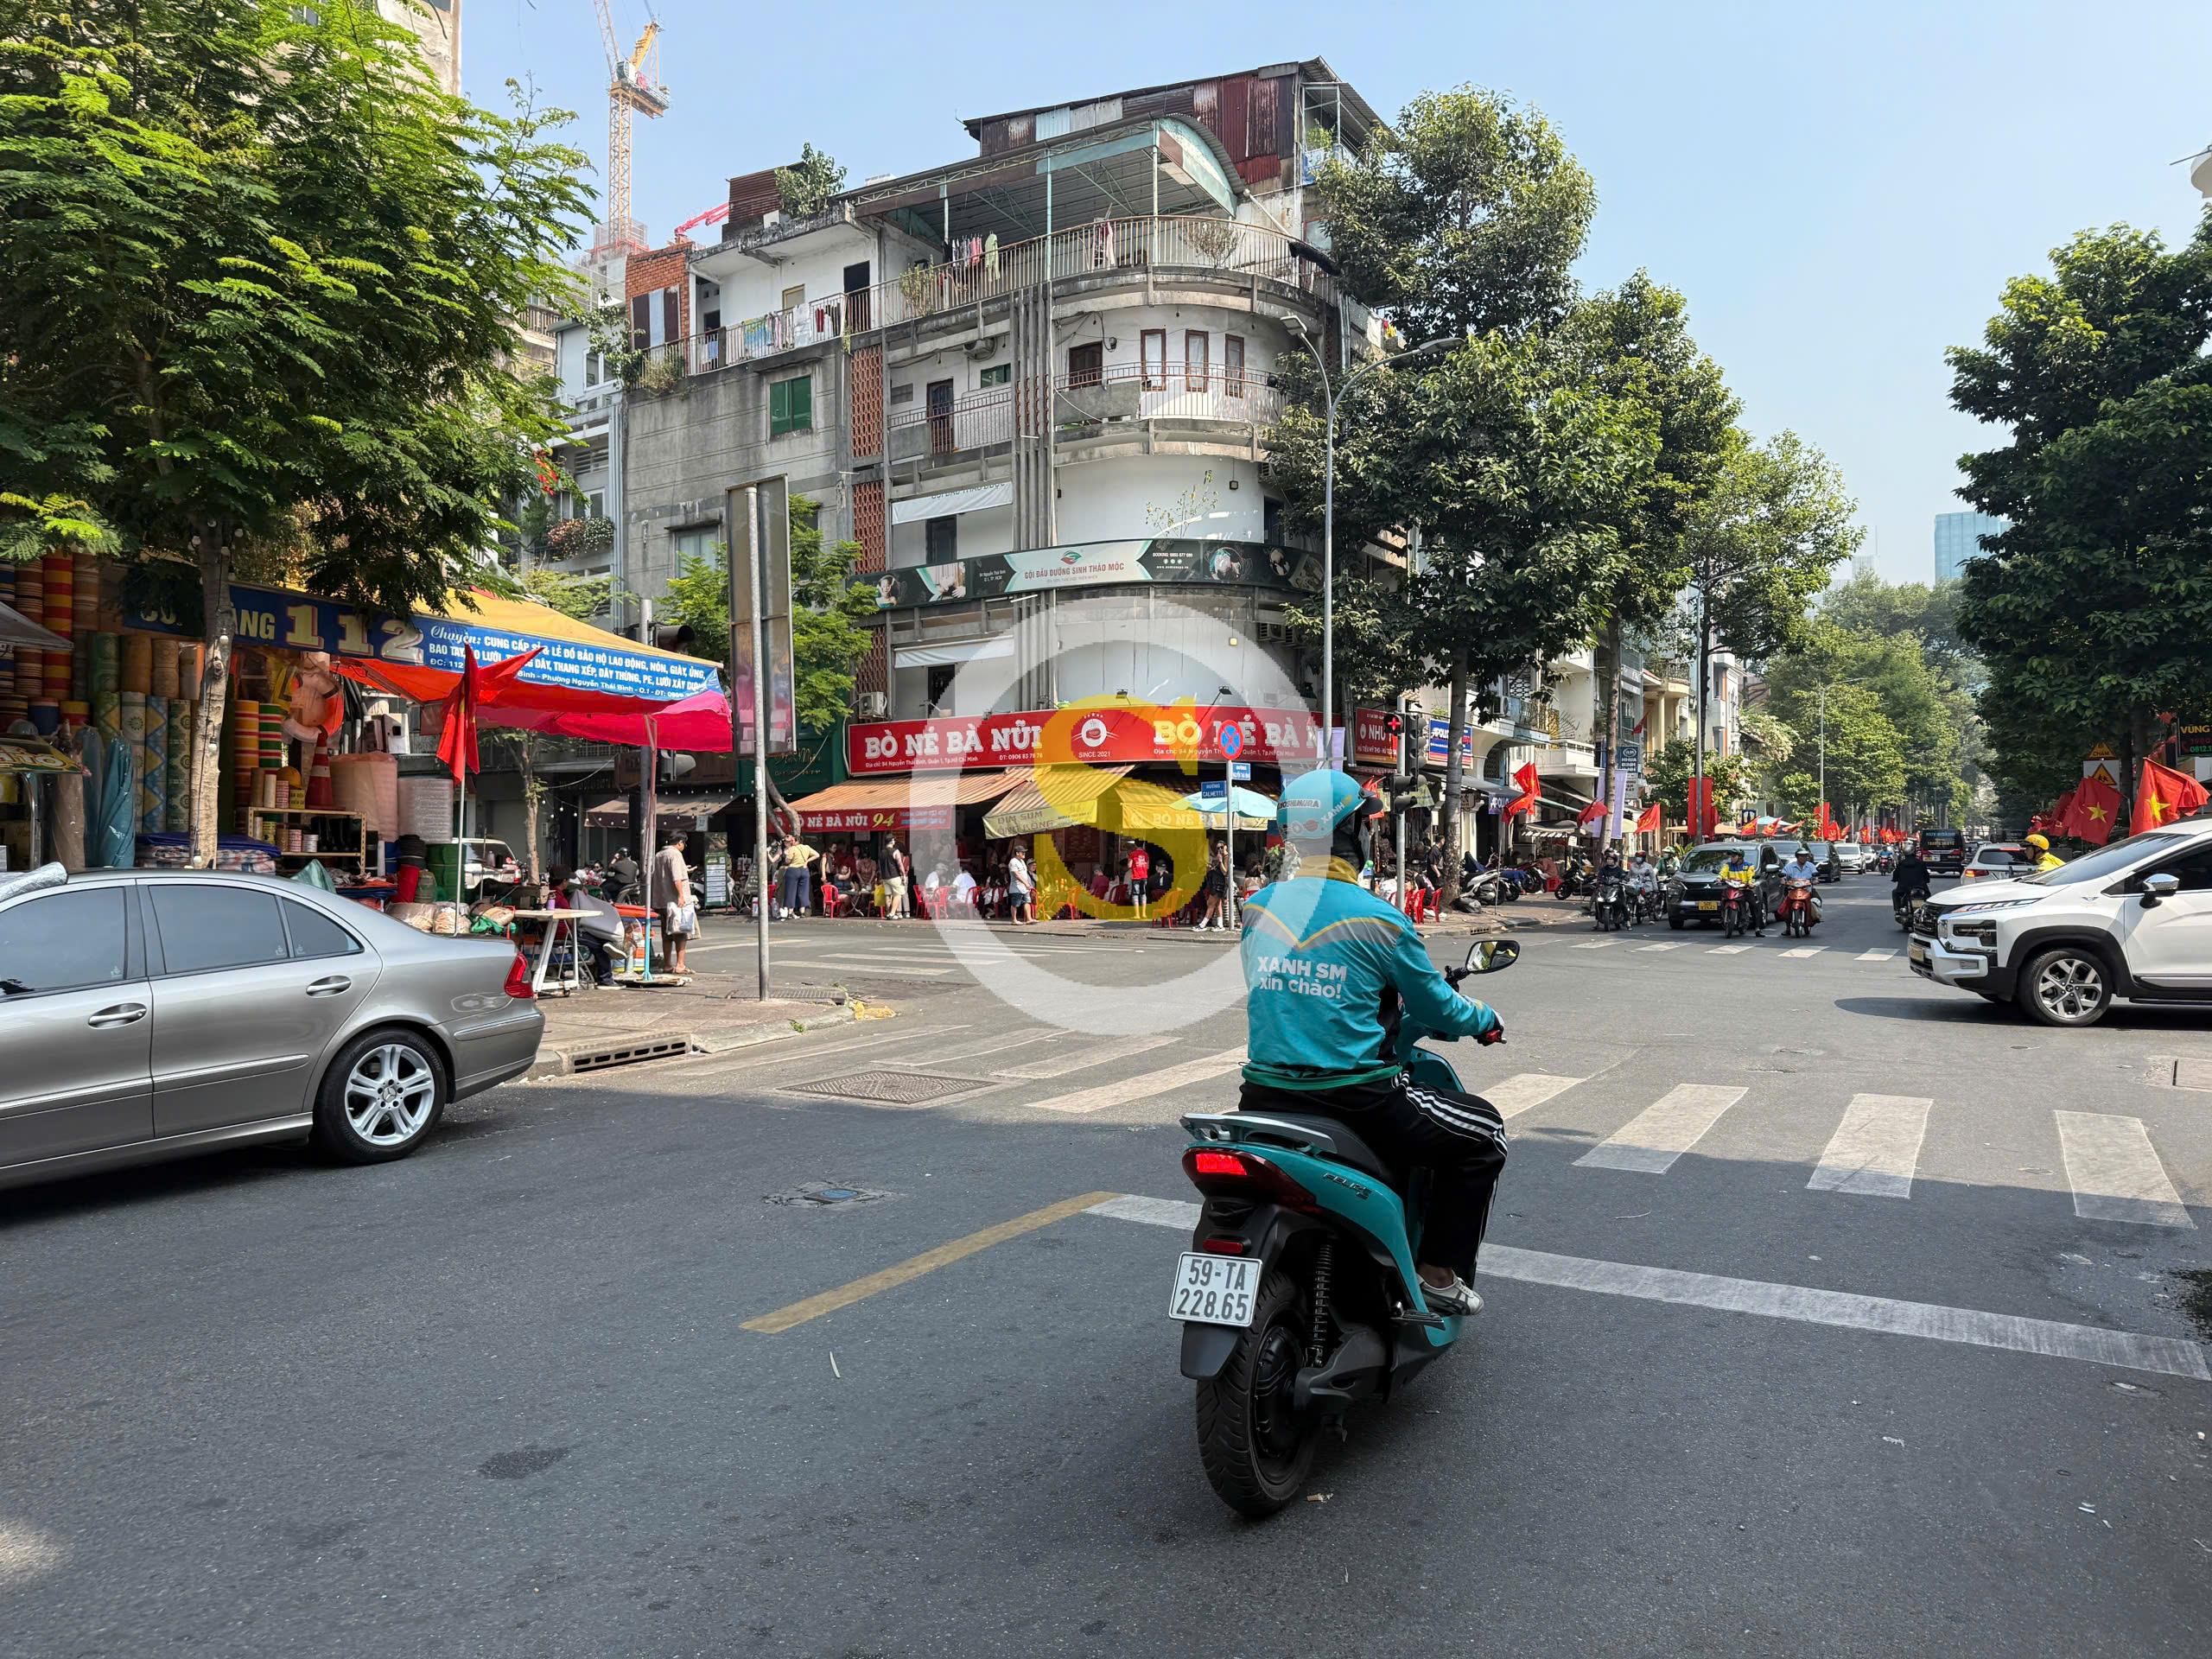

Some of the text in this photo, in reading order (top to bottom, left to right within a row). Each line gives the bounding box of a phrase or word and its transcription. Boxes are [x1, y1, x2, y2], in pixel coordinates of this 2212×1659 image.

[1071, 566, 1087, 575] SINH
[429, 643, 448, 655] BAO
[554, 661, 580, 674] THANG
[484, 636, 510, 649] CUNG
[511, 639, 530, 652] CẤP
[608, 655, 622, 667] LAO
[865, 729, 898, 759] BÒ
[906, 726, 939, 756] NÉ
[946, 722, 983, 754] BÀ
[1153, 713, 1202, 745] BÒ
[1265, 716, 1300, 748] BÀ
[808, 814, 823, 827] NÉ
[826, 812, 842, 827] BÀ
[872, 812, 895, 829] 94
[1020, 810, 1043, 821] SUM
[1257, 957, 1347, 982] XANH SM
[1260, 977, 1342, 999] xin chào!
[1188, 1258, 1246, 1290] 59-TA
[1177, 1287, 1249, 1321] 228.65
